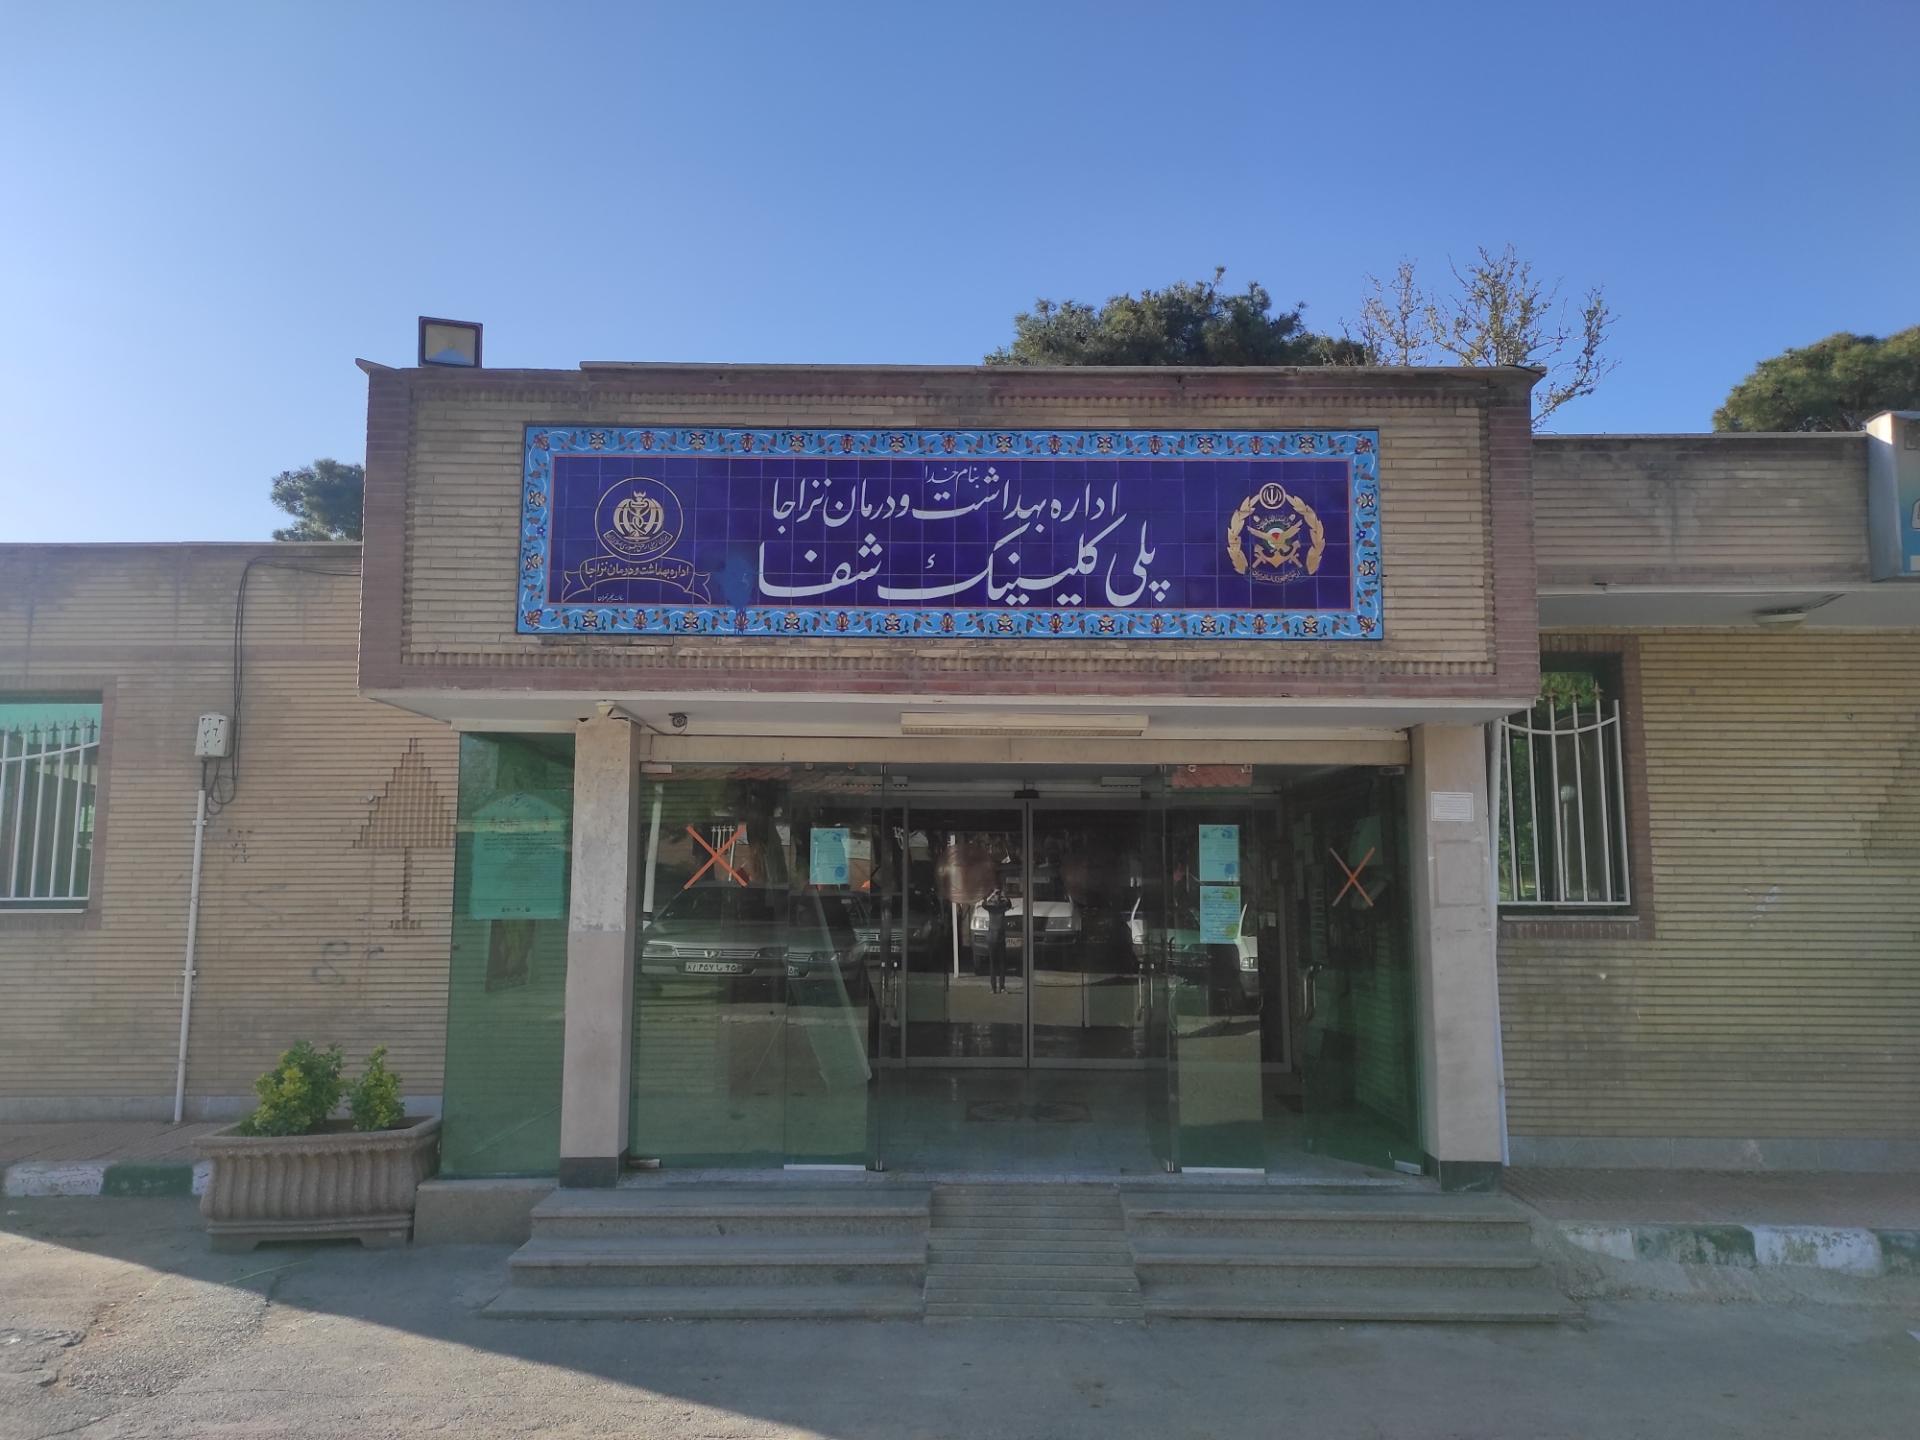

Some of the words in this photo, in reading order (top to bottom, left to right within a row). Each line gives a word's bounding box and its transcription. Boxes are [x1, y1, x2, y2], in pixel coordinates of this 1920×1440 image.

[911, 466, 1047, 533] بهداشت
[925, 465, 959, 484] خدا
[955, 465, 981, 492] بنام
[1050, 481, 1118, 522] اداره
[772, 477, 832, 535] نزاجا
[758, 532, 884, 598] شفا
[876, 512, 1127, 606] کلینیک
[1105, 519, 1171, 607] پلی
